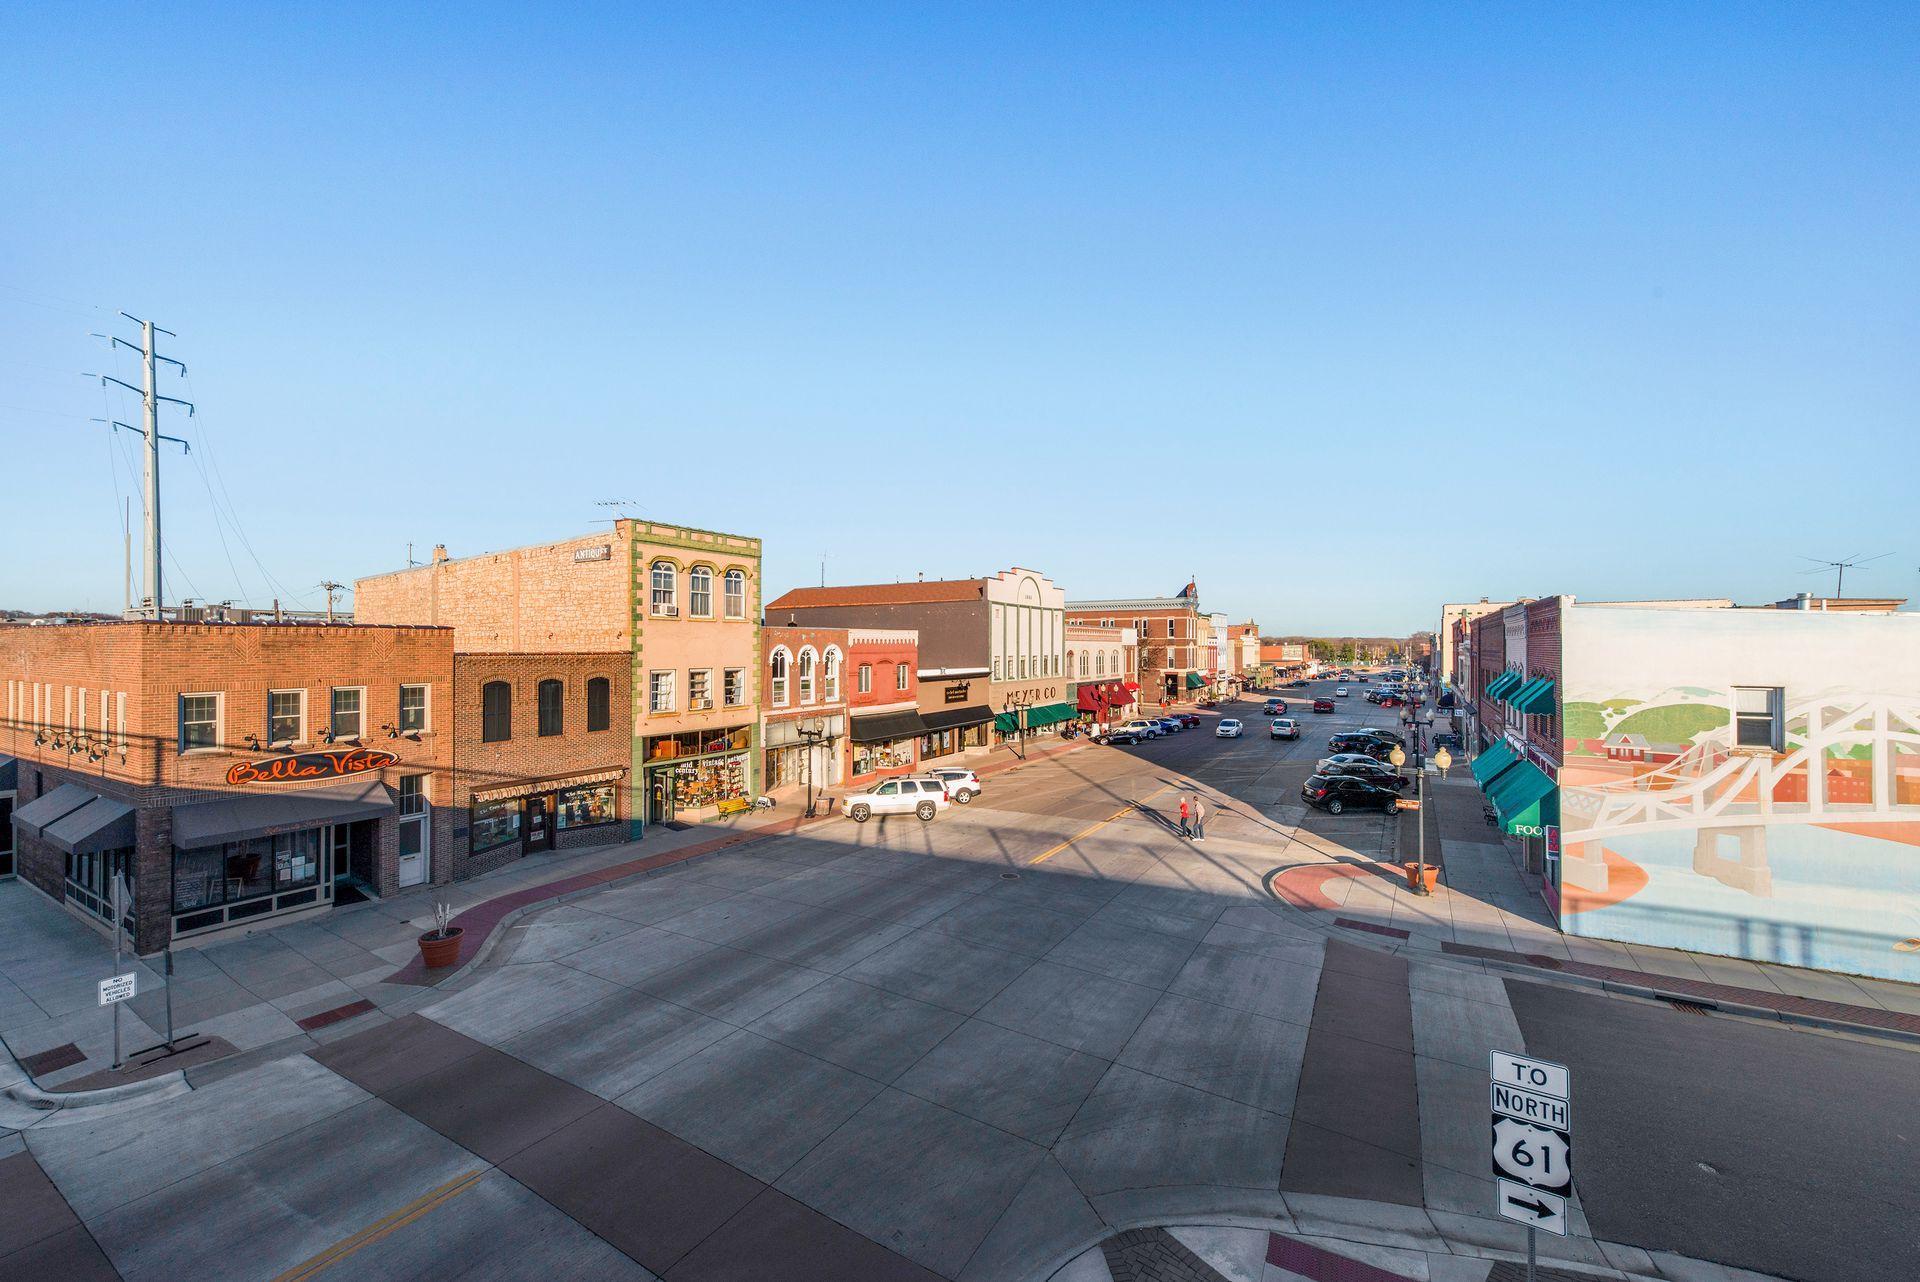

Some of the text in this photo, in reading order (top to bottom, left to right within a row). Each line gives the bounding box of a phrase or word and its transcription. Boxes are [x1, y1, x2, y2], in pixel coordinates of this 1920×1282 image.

[1006, 686, 1056, 705] MEYER CO
[226, 747, 402, 785] Bella Vista
[675, 767, 699, 776] century
[1548, 828, 1559, 852] ATM
[102, 980, 133, 992] MOTORIZED
[105, 986, 131, 997] VEHICLES
[105, 992, 131, 1003] ALLOWED
[1511, 1062, 1548, 1086] TO
[1496, 1088, 1565, 1124] NORTH
[1511, 1139, 1551, 1174] 61
